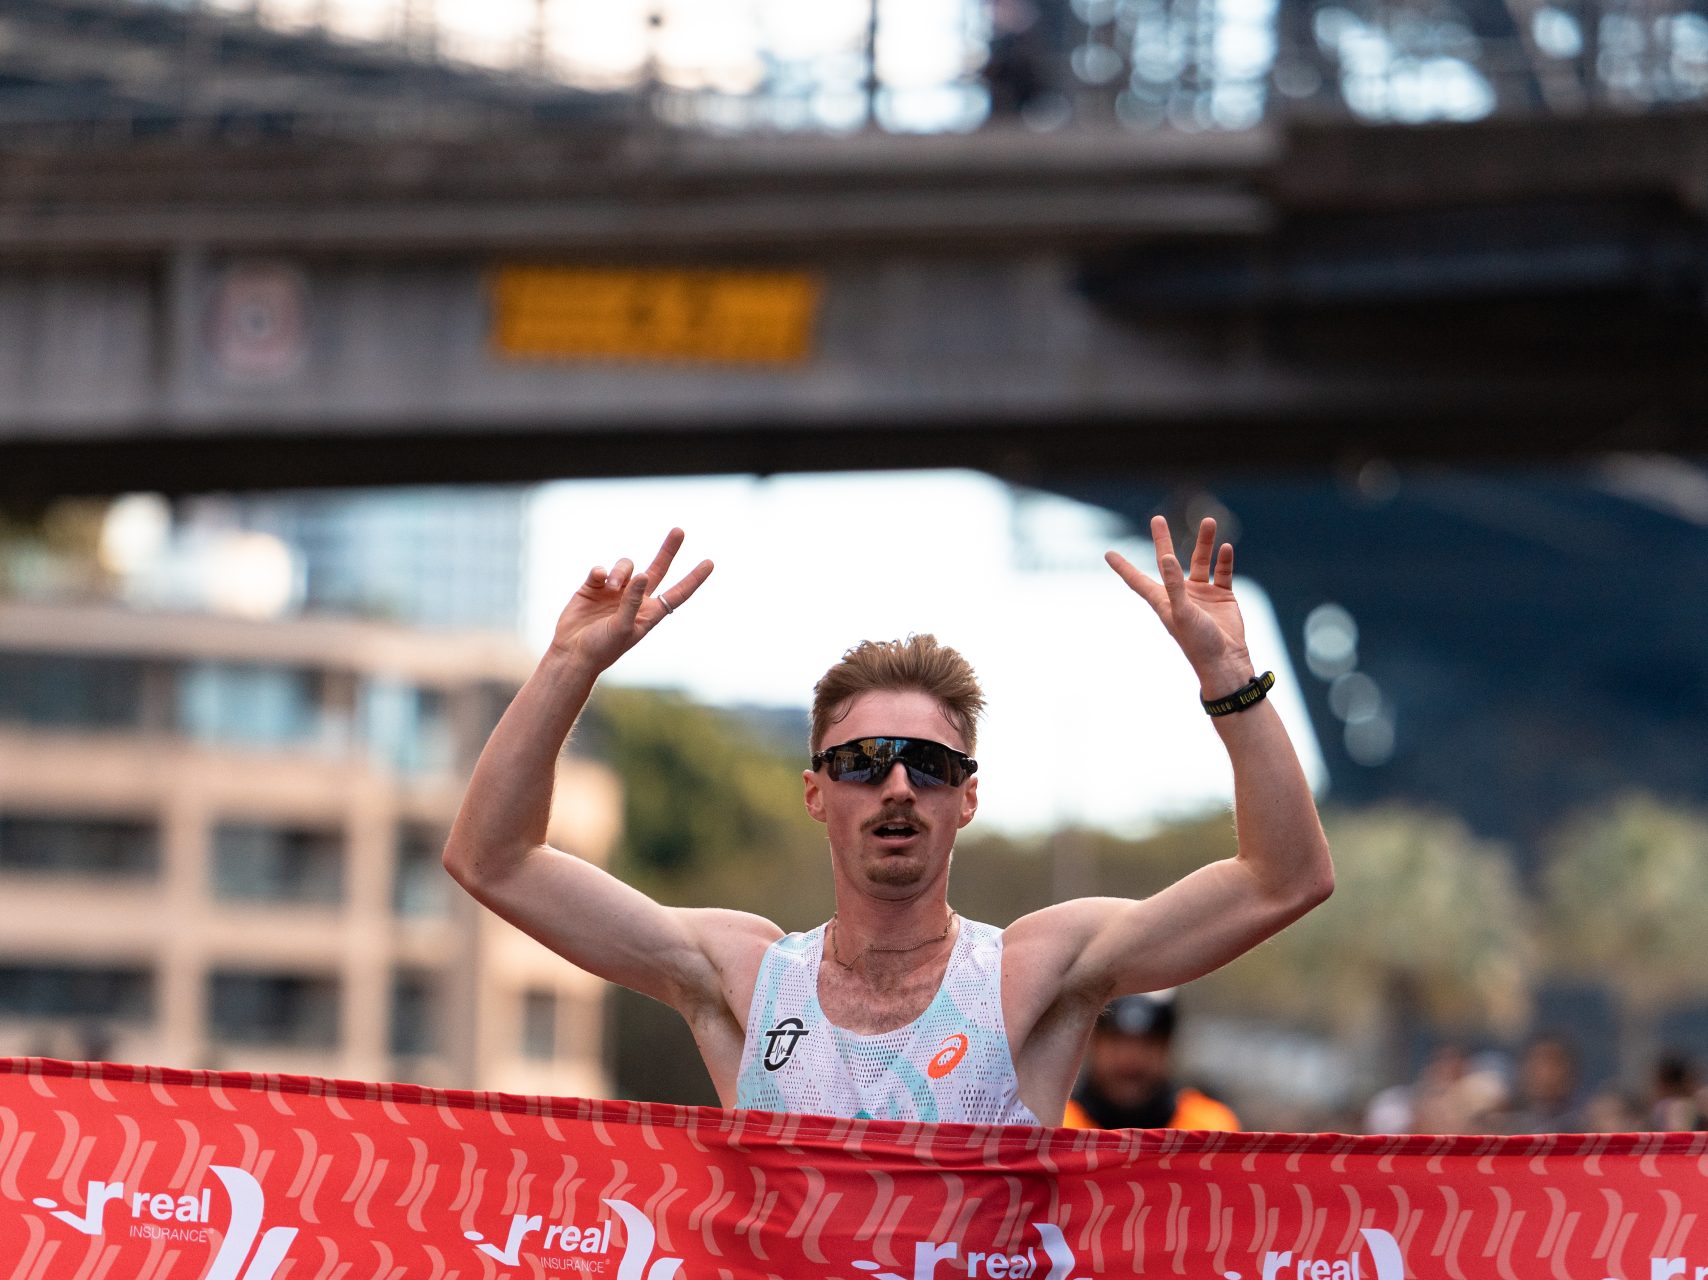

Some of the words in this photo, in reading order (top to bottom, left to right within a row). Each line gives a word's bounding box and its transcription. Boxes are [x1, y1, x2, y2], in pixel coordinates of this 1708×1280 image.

[131, 1188, 211, 1223] real
[129, 1224, 208, 1243] INSURANCE
[543, 1219, 612, 1254] real
[540, 1256, 605, 1274] INSURANCE
[967, 1246, 1038, 1280] real
